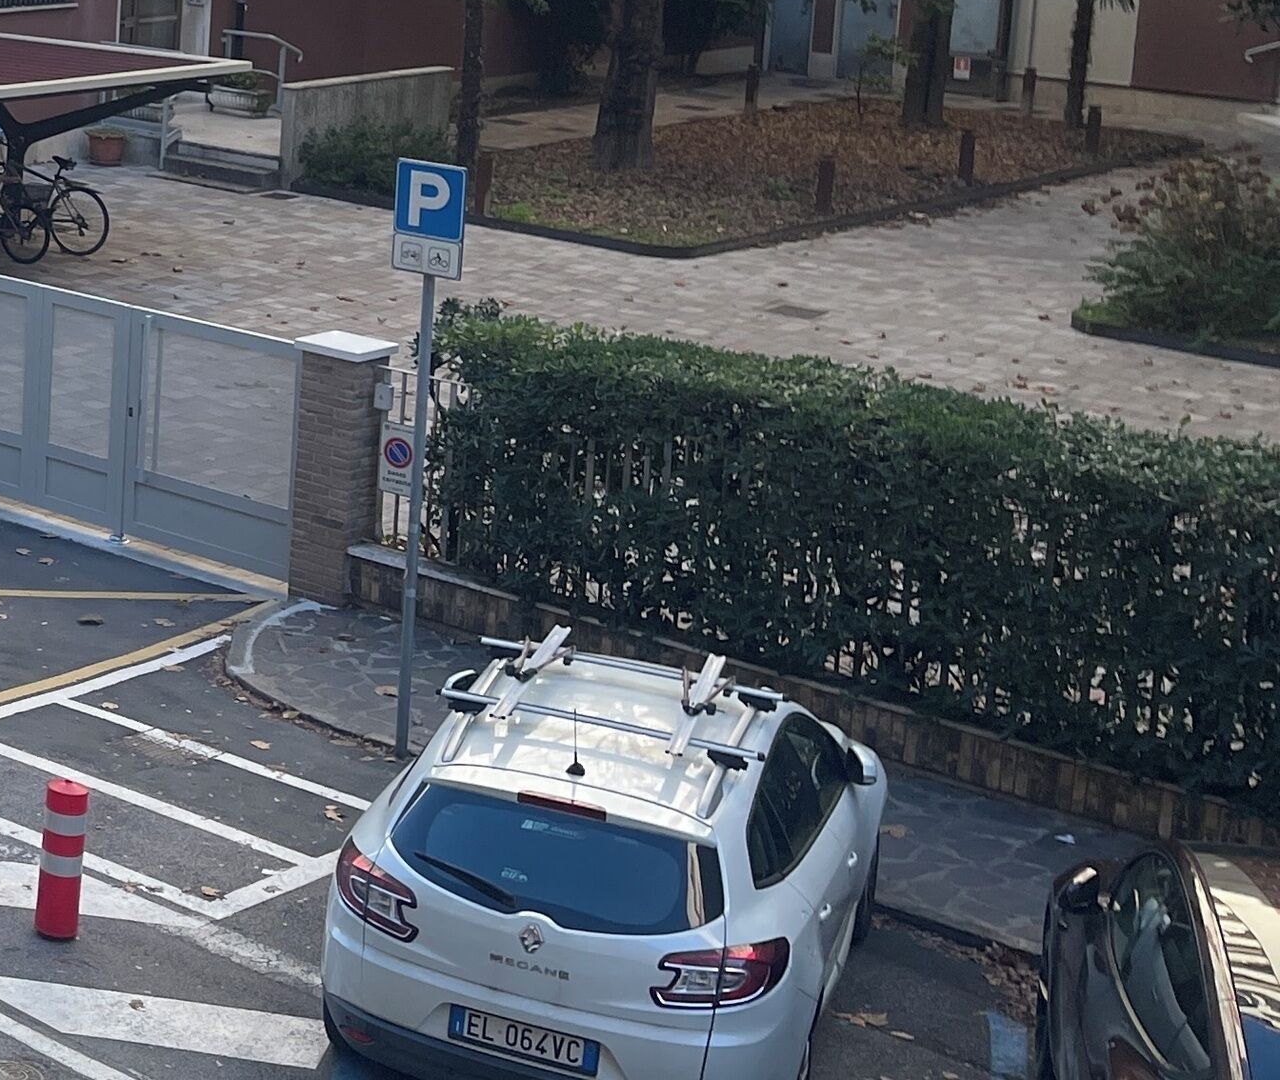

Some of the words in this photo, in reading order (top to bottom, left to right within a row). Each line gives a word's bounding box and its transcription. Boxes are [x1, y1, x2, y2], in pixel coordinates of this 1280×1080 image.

[408, 169, 450, 227] P
[490, 953, 570, 981] MEGANE
[466, 1012, 494, 1042] EL
[505, 1024, 580, 1064] 064VC
